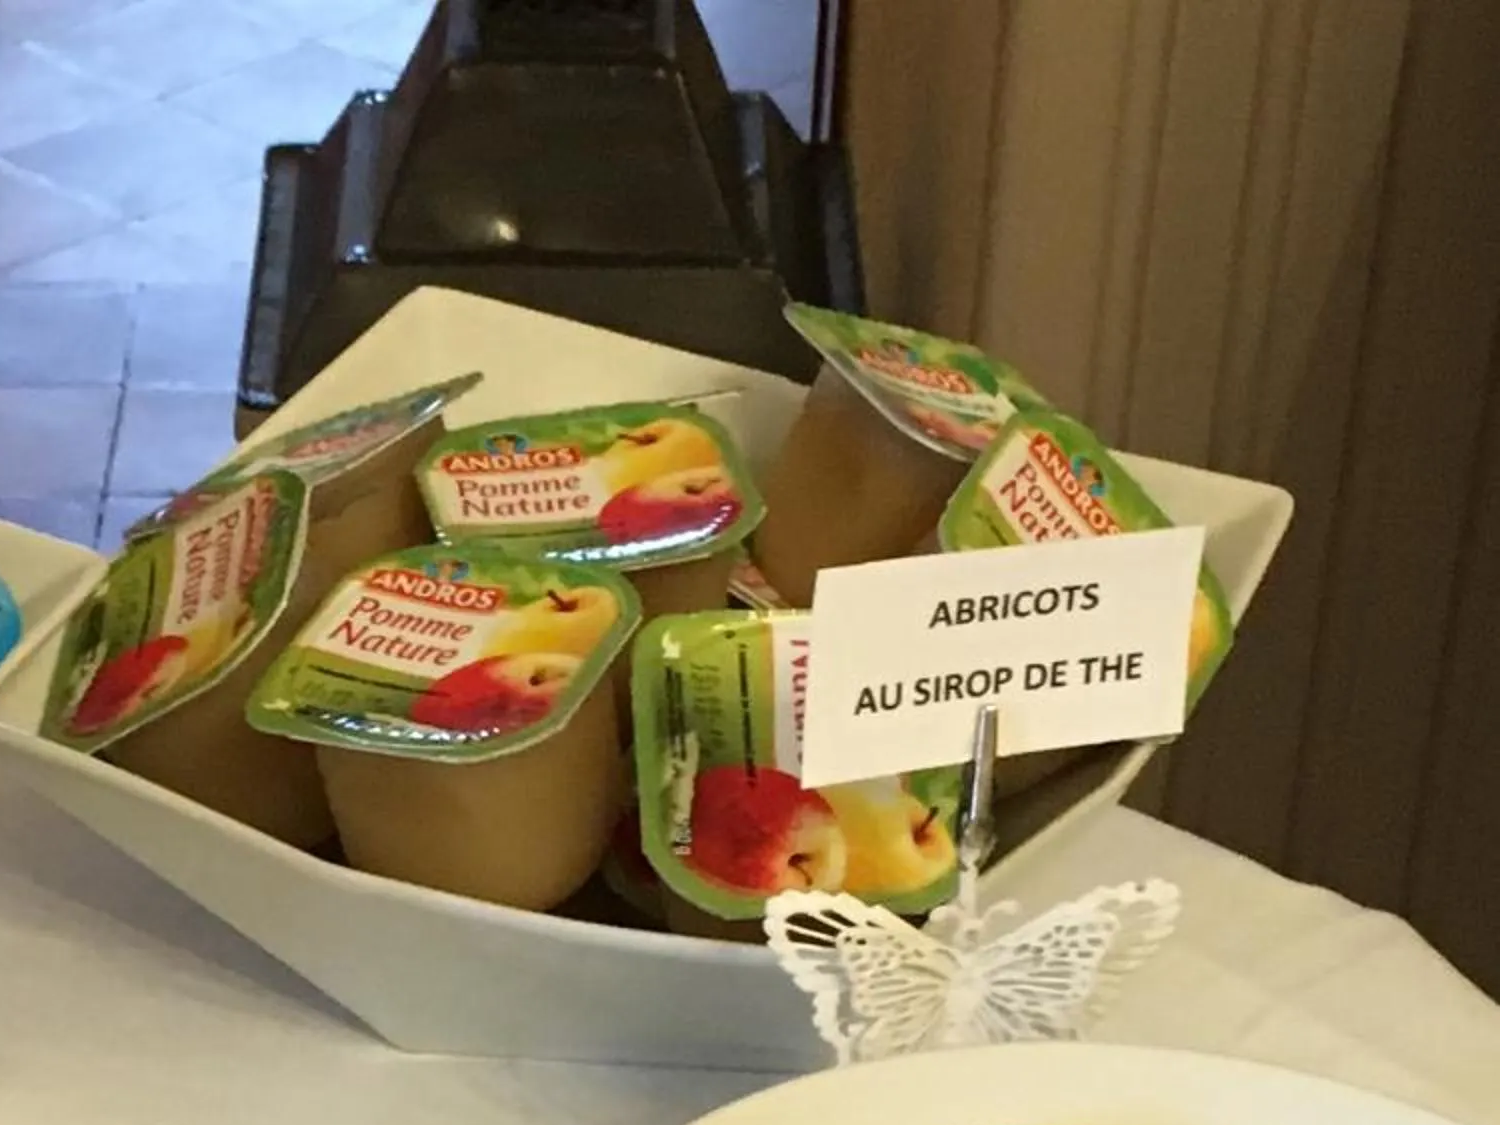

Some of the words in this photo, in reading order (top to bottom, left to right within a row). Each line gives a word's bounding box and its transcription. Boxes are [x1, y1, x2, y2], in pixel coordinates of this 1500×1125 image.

[450, 447, 574, 471] ANDROS
[456, 475, 581, 498] Pomme
[462, 494, 590, 517] Nature
[178, 526, 212, 624] Nature
[210, 509, 240, 601] Pomme
[372, 571, 496, 609] ANDROS
[929, 583, 1100, 628] ABRICOTS
[349, 596, 473, 641] Pomme
[328, 619, 459, 666] Nature
[854, 682, 902, 715] AU
[913, 667, 1013, 706] SIROP
[1024, 660, 1068, 690] DE
[1078, 652, 1143, 685] THE
